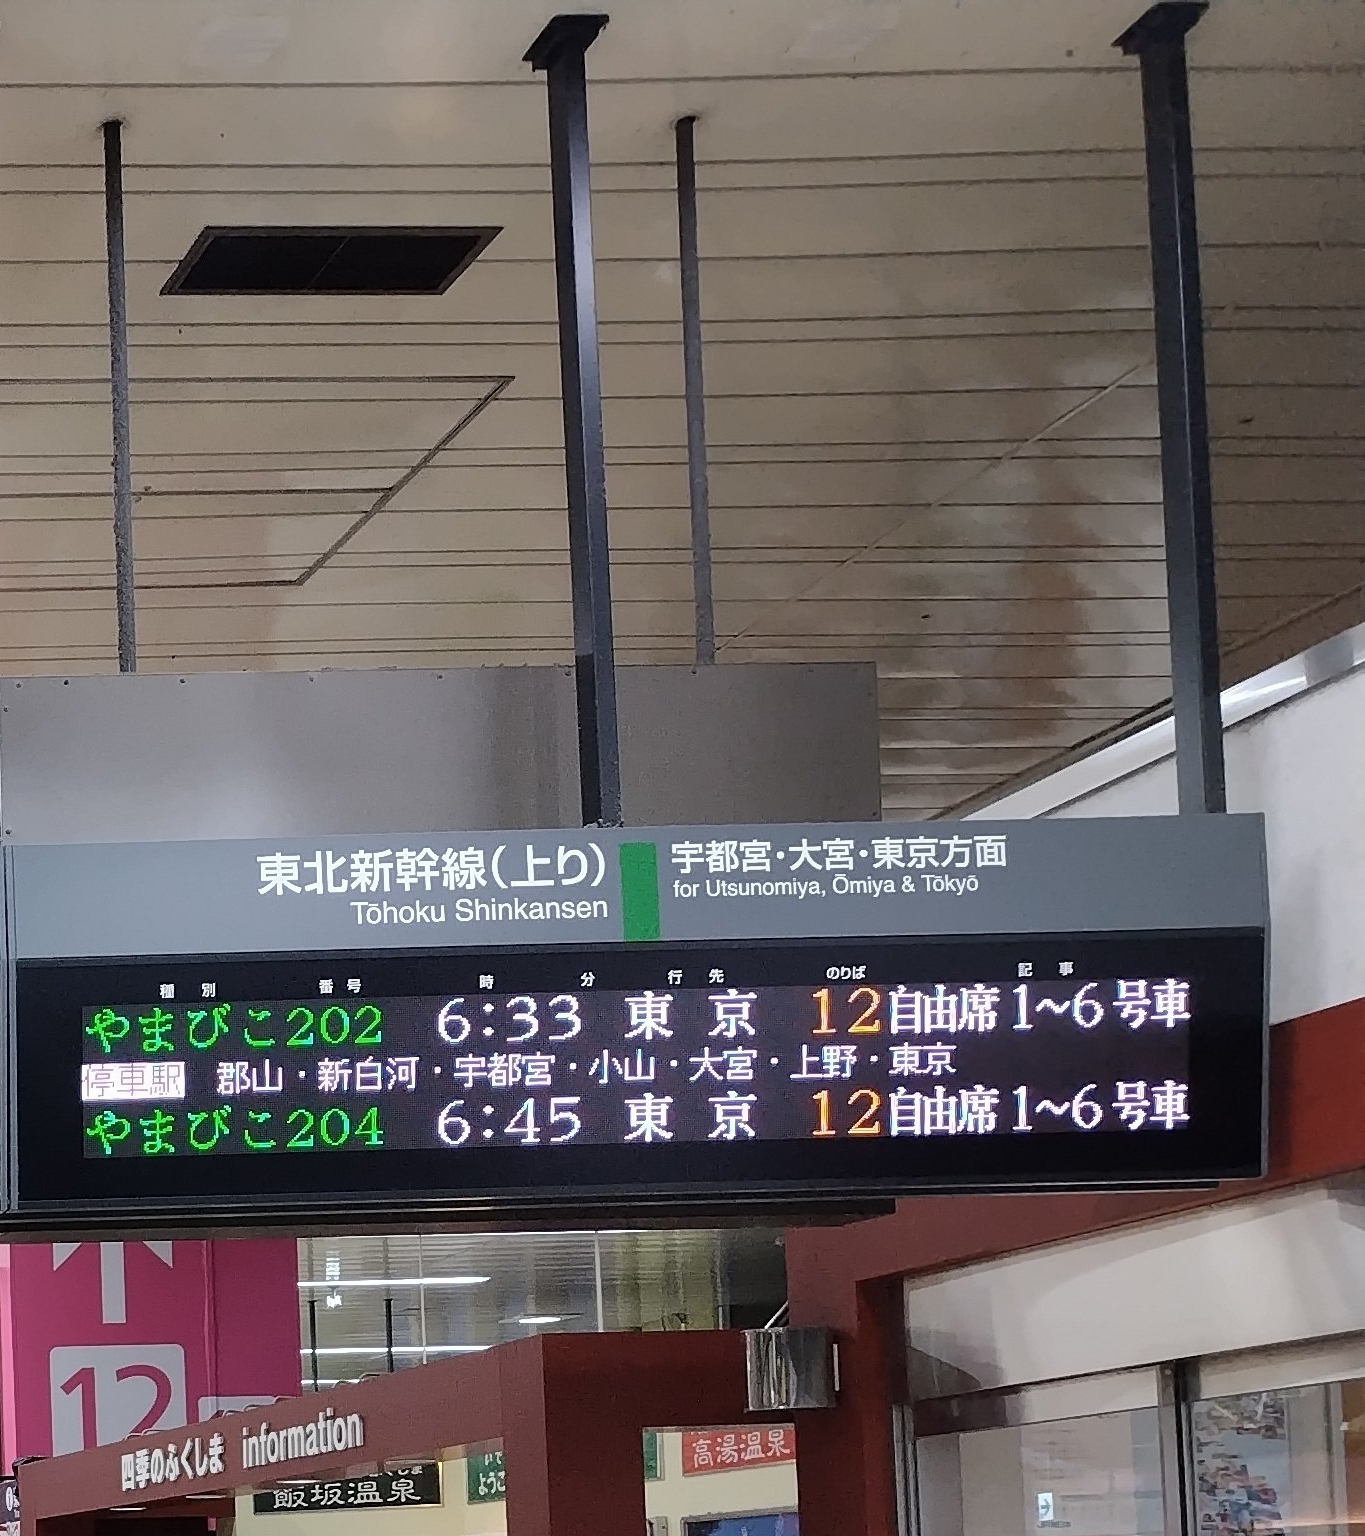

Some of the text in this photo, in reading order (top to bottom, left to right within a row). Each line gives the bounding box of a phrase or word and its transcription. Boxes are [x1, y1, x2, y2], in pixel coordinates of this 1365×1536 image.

[672, 835, 1007, 873] 宇都宮・大宮・東京方面
[673, 873, 978, 899] for Utsunomiya, Ōmiya & Tōkyō
[351, 897, 608, 925] Tōhoku Shinkansen
[826, 966, 867, 980] のりば
[437, 996, 582, 1045] 6:33
[812, 988, 881, 1035] 12
[437, 1096, 582, 1146] 6:45
[813, 1090, 881, 1136] 12
[58, 1364, 173, 1457] 12
[121, 1408, 364, 1491] 四季のふくしま information
[692, 1429, 791, 1469] 高湯温泉
[274, 1478, 421, 1509] 飯坂温泉
